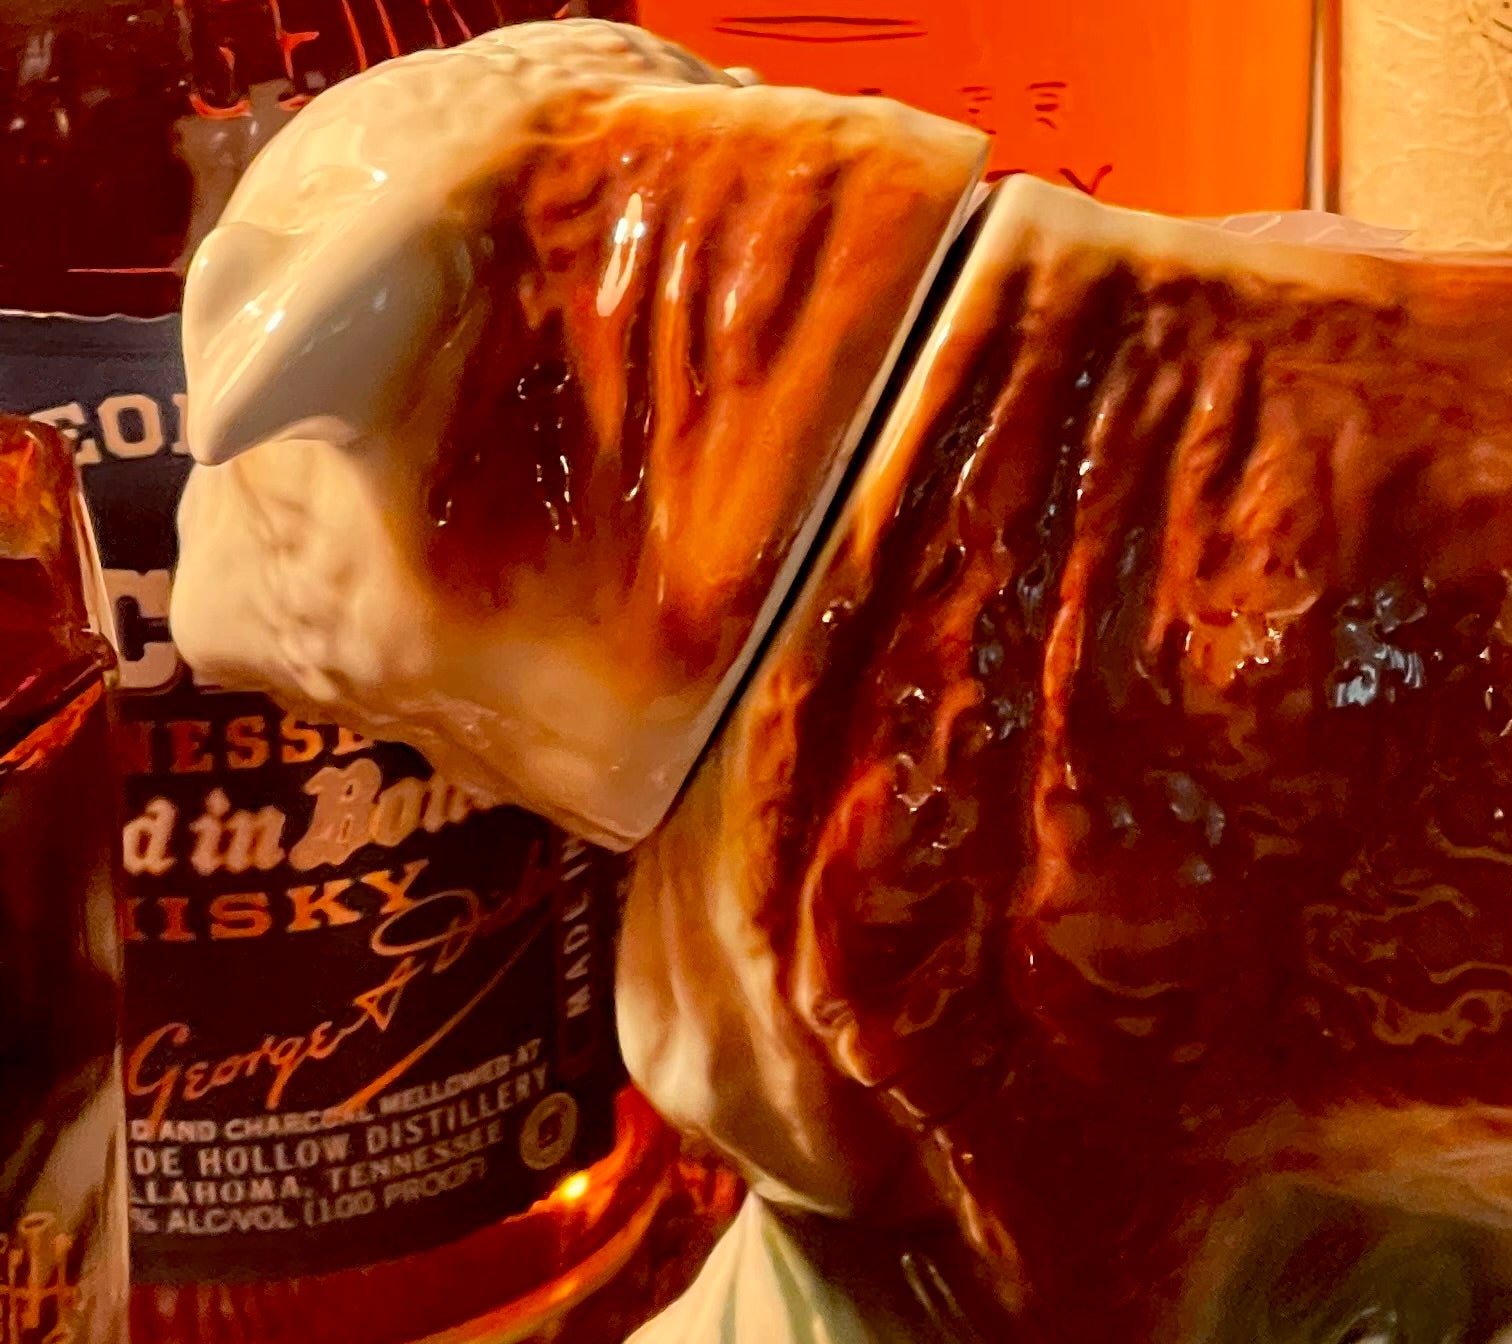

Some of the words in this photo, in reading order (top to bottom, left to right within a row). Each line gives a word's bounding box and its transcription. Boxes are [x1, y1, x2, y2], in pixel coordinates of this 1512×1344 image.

[190, 788, 286, 876] in
[159, 1119, 217, 1143] AND
[197, 1132, 350, 1178] HOLLOW
[365, 1061, 549, 1155] DISTILLERY
